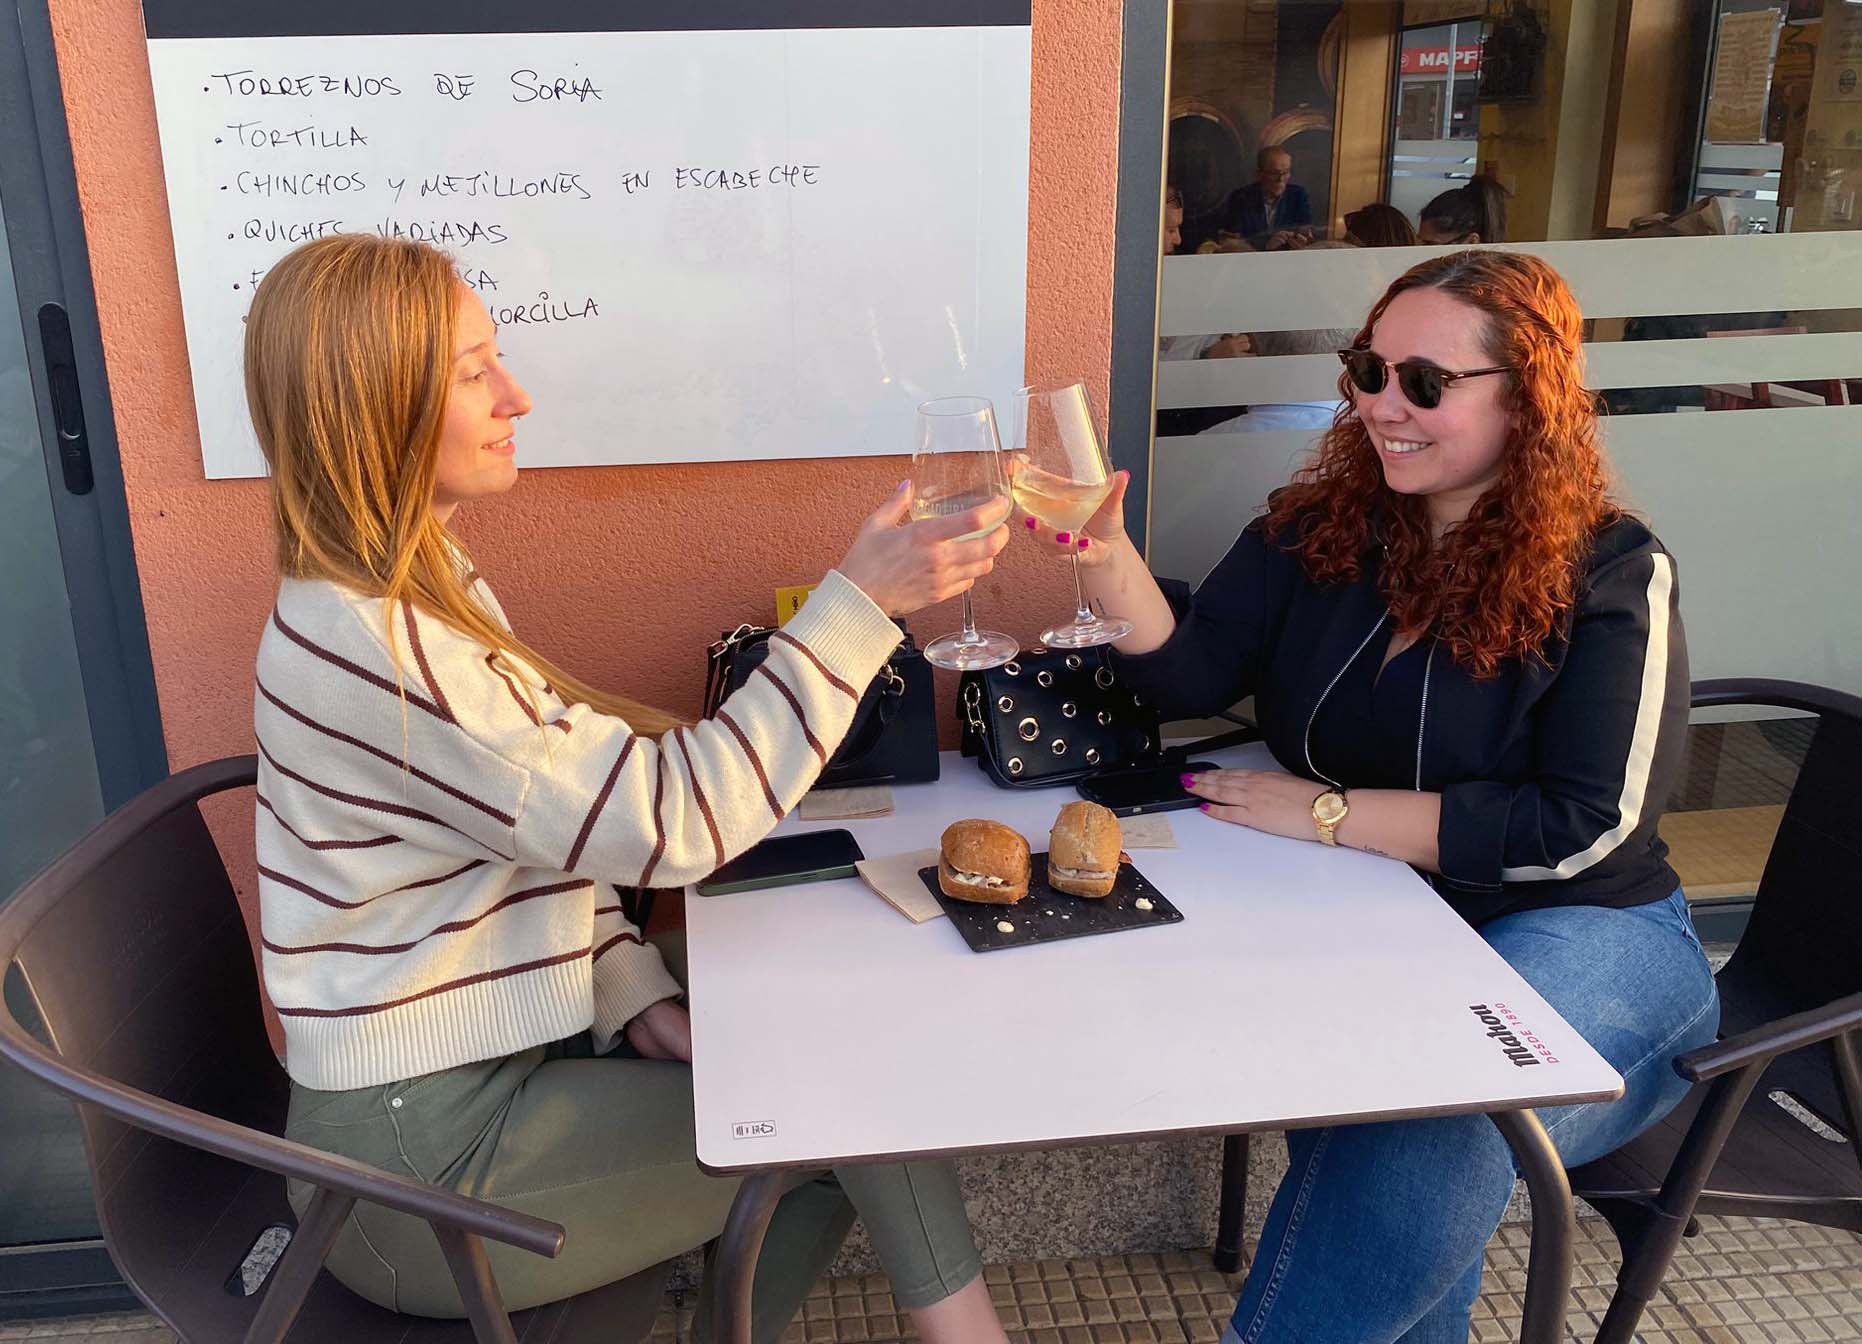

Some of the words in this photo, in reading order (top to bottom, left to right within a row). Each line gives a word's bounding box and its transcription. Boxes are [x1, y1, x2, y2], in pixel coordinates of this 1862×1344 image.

[210, 69, 402, 98] TORREZNOS
[433, 73, 475, 100] DE
[226, 115, 368, 148] TORTILLA
[237, 170, 366, 198] CHINCHOS
[420, 170, 592, 200] MEJILLONES
[621, 170, 650, 195] EN
[676, 164, 821, 191] ESCABECHE
[376, 217, 508, 248] VARIADAS
[490, 291, 599, 326] ORCILLA
[1519, 1029, 1560, 1064] DESDE
